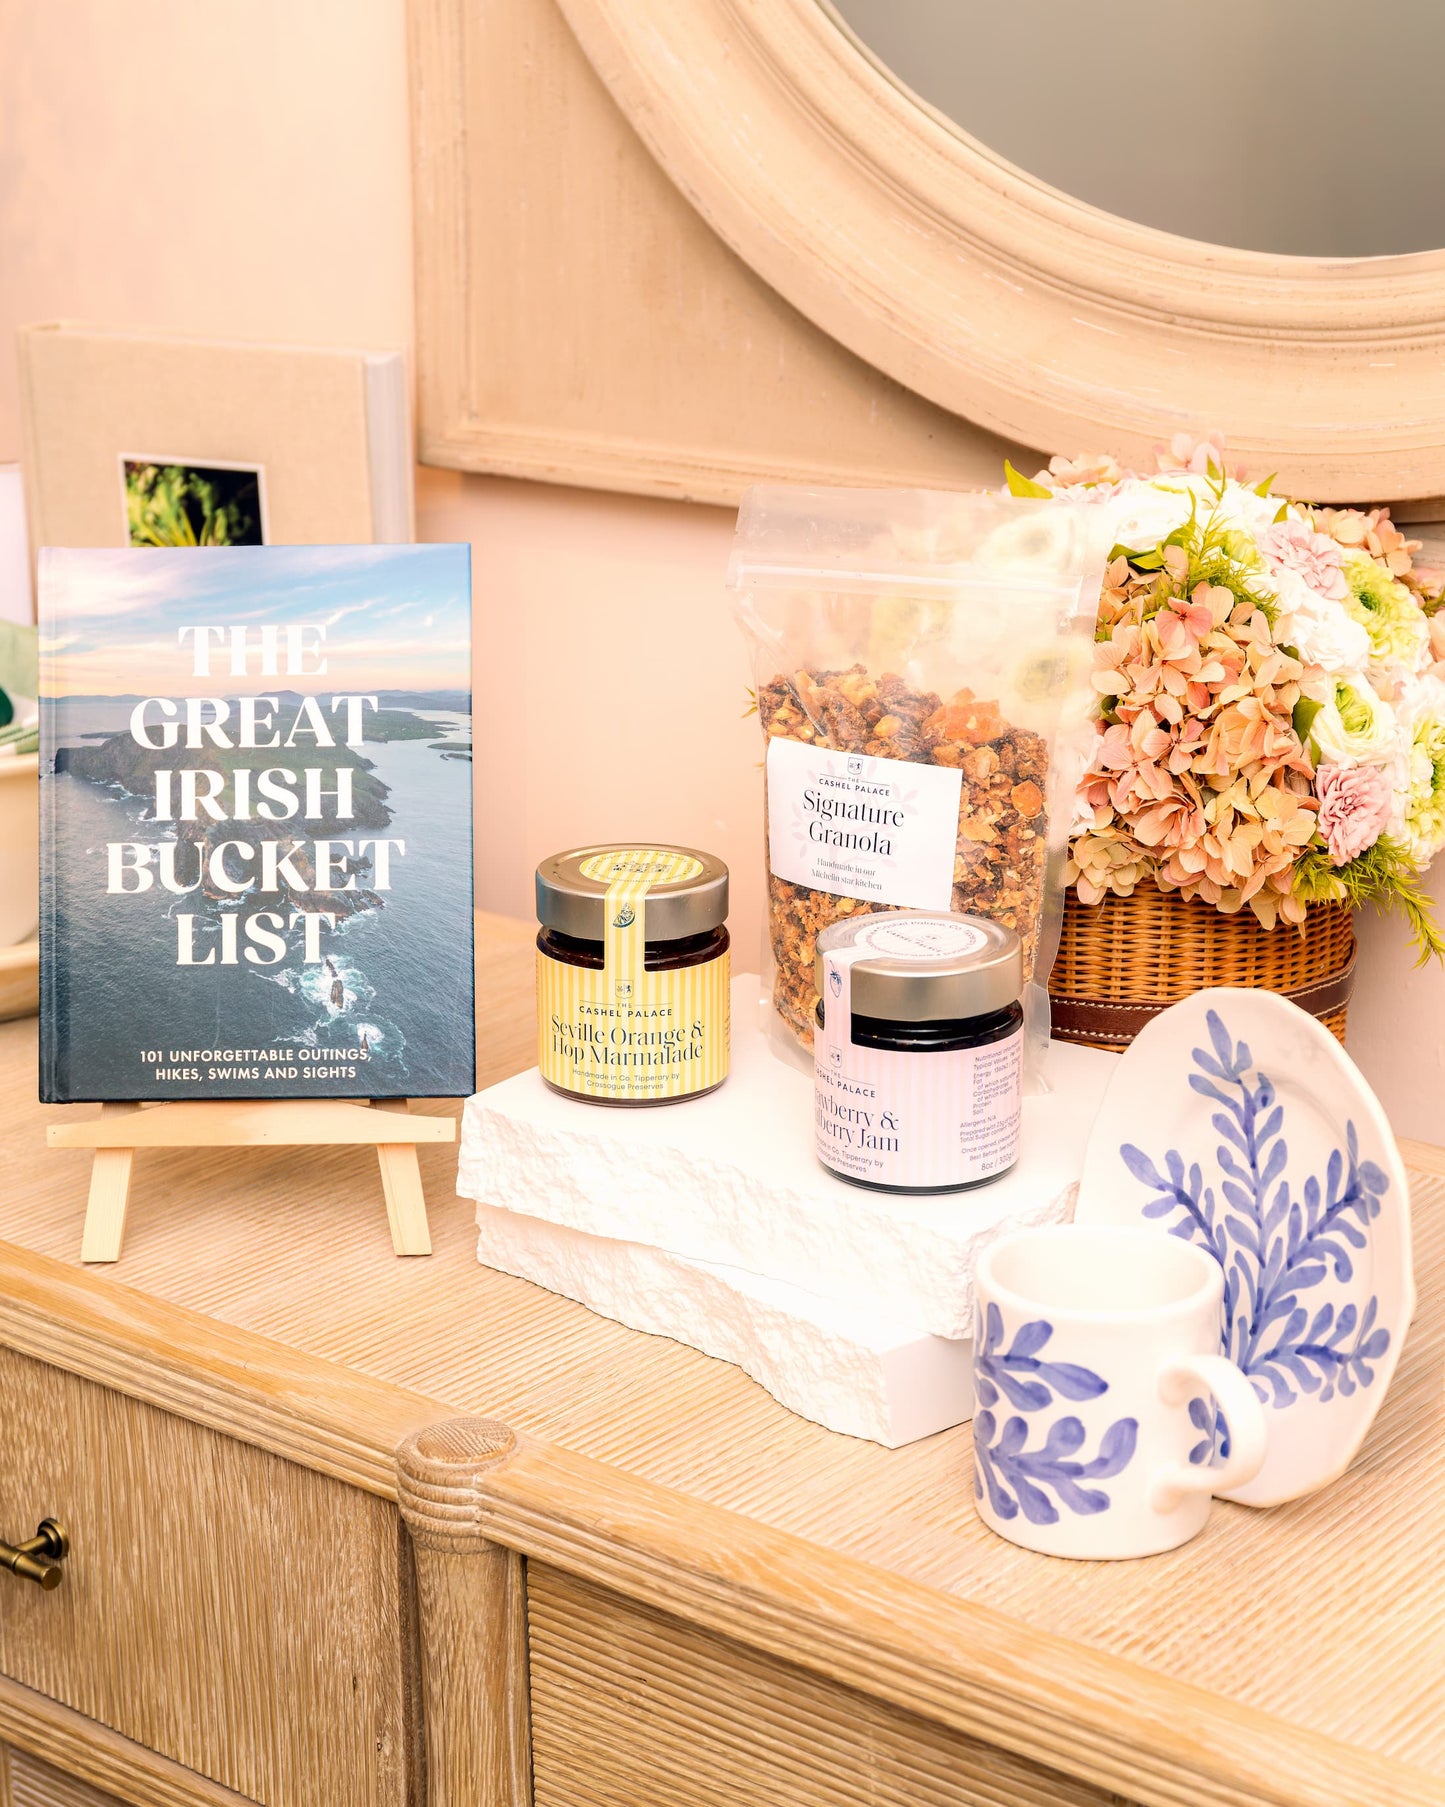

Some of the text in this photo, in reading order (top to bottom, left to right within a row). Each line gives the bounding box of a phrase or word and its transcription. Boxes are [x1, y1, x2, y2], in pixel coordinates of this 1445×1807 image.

[178, 624, 328, 677] THE
[129, 695, 379, 750] GREAT
[154, 767, 355, 822] IRISH
[818, 777, 891, 797] CASHEL PALACE
[803, 788, 905, 828] Signature
[809, 820, 894, 856] Granola
[106, 839, 406, 895] BUCKET
[816, 857, 877, 877] Handmade in our
[811, 868, 883, 891] Michelin star kitchen
[176, 912, 336, 966] LIST
[579, 1005, 673, 1018] CASHEL PALACE
[551, 1014, 605, 1044] Seville
[610, 1026, 686, 1048] Orange
[691, 1019, 705, 1039] &
[139, 1048, 373, 1063] 101 UNFORGETTABLE OUTINGS,
[552, 1034, 704, 1066] Hop Marmalade
[155, 1066, 356, 1082] HIKES, SWIMS AND SIGHTS
[572, 1068, 609, 1080] Handmade
[610, 1073, 617, 1081] in
[634, 1073, 670, 1084] Tipperary
[671, 1071, 680, 1081] by
[816, 1066, 876, 1098] ASHEL PALACE
[880, 1110, 900, 1131] &
[857, 1128, 900, 1152] Jam
[836, 1156, 867, 1173] Preserves
[841, 1150, 873, 1167] Tipperary
[874, 1159, 884, 1168] by
